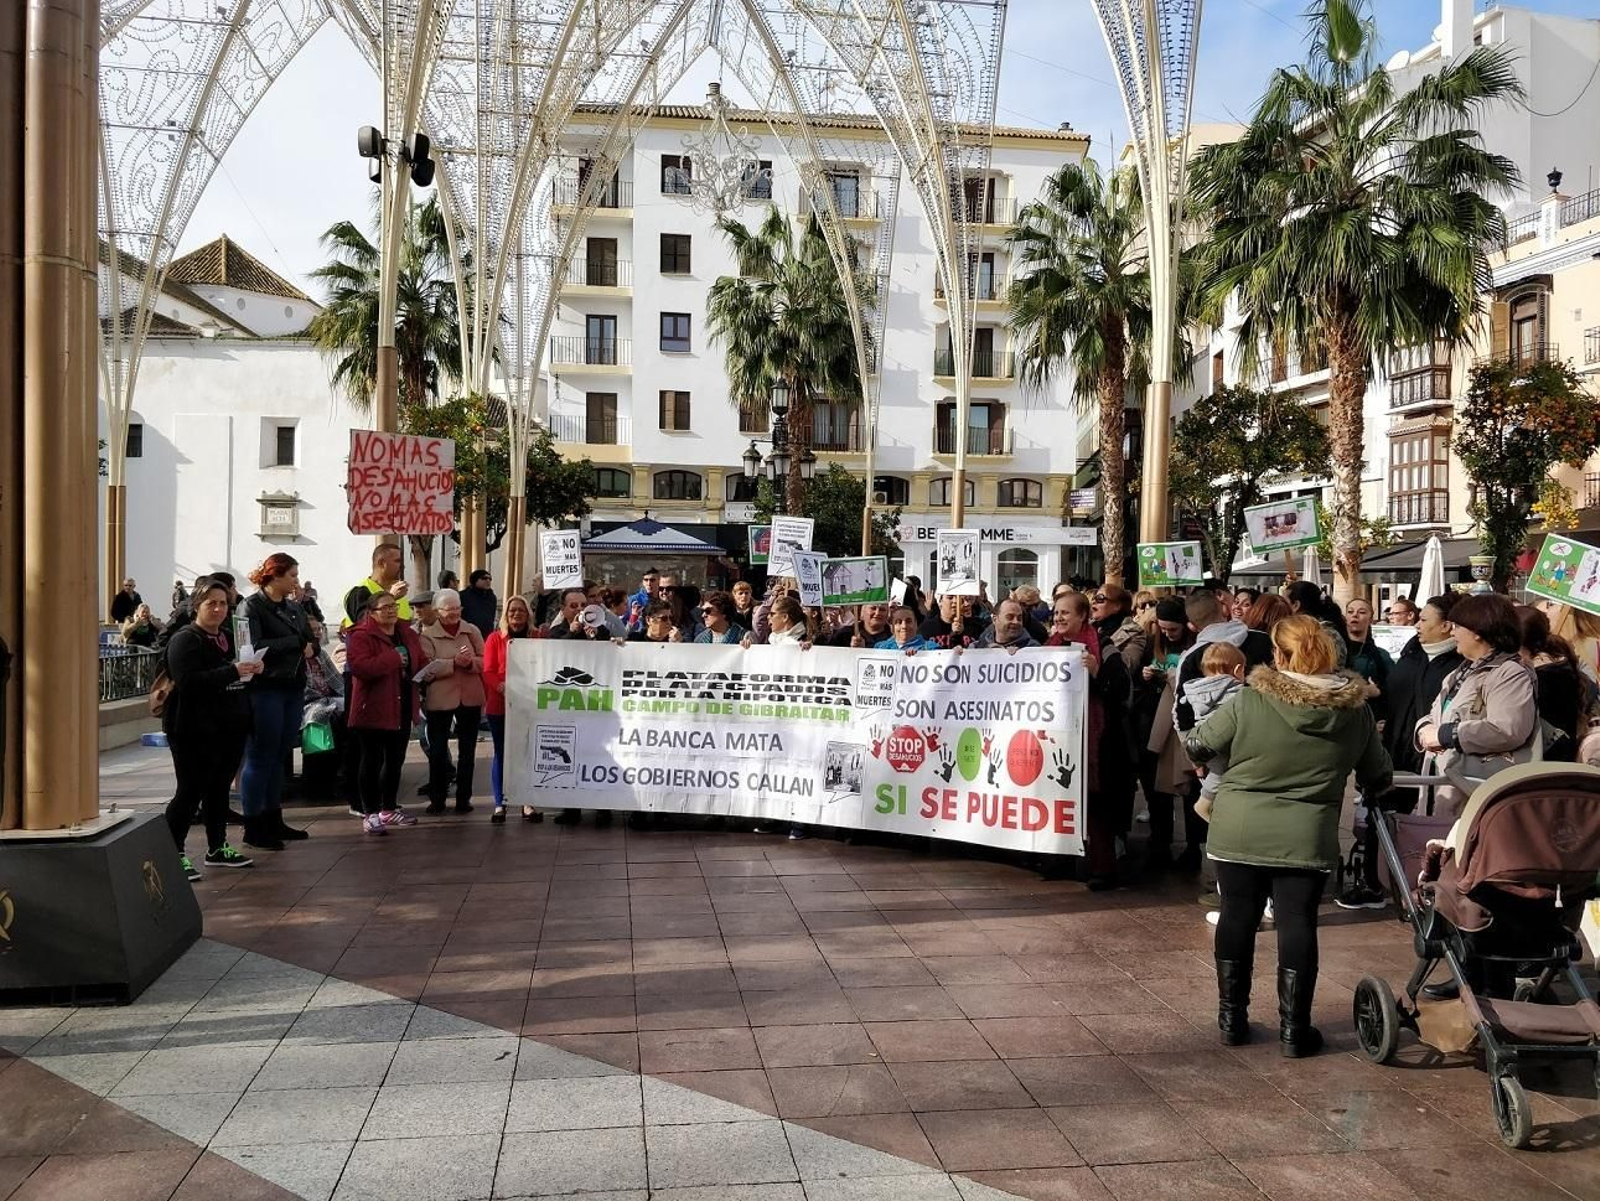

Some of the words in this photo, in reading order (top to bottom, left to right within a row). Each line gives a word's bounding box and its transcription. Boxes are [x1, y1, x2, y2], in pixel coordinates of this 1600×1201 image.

[352, 510, 454, 534] ASESINATOS
[562, 538, 576, 549] NO
[545, 564, 578, 574] MUERTES
[622, 670, 852, 686] PLATAFORMA
[880, 664, 895, 678] NO
[900, 664, 928, 684] NO
[931, 664, 971, 685] SON
[977, 661, 1072, 684] SUICIDIOS
[622, 679, 661, 689] DE
[668, 681, 848, 696] AFECTADOS
[536, 685, 615, 713] PAH
[621, 689, 677, 699] POR
[683, 690, 717, 700] LA
[722, 692, 852, 707] HIPOTECA
[857, 694, 892, 707] MUERTES
[622, 699, 700, 714] CAMPO
[705, 702, 733, 715] DE
[739, 703, 851, 721] GIBRALTAR
[894, 699, 936, 720] SON
[944, 700, 1055, 723] ASESINATOS
[619, 727, 641, 747] LA
[646, 729, 716, 750] BANCA
[725, 732, 784, 752] MATA
[889, 737, 922, 754] STOP
[888, 752, 923, 763] DESAHUCIOS
[581, 764, 619, 784] LOS
[623, 766, 740, 790] GOBIERNOS
[747, 772, 814, 798] CALLAN
[875, 783, 907, 815] SI
[920, 787, 959, 821] SE
[967, 791, 1076, 836] PUEDE
